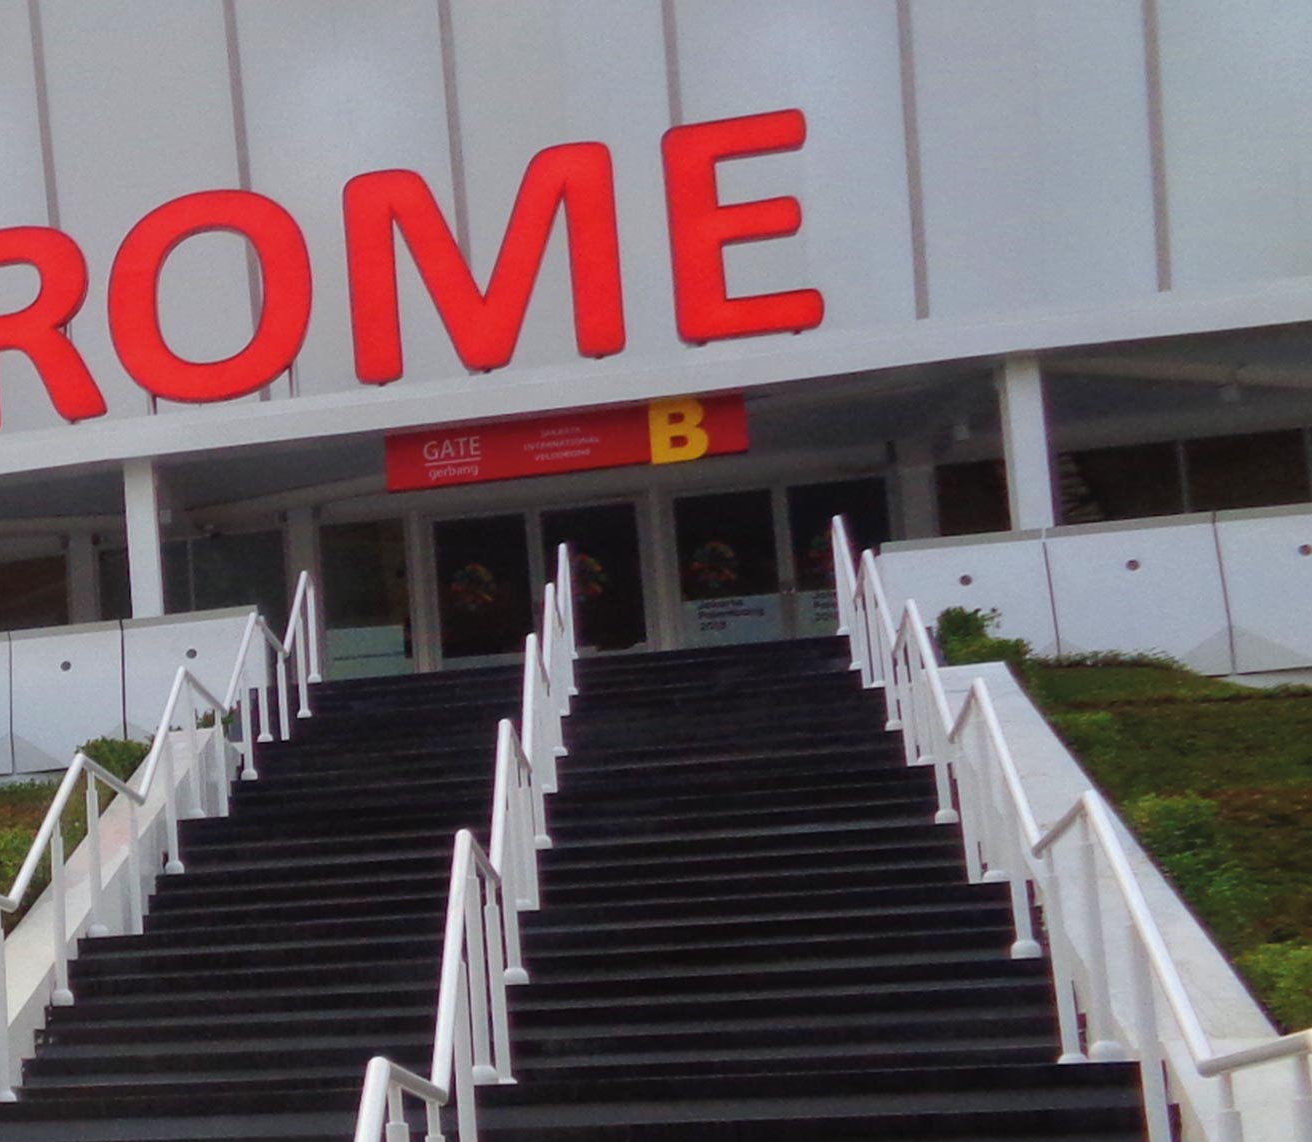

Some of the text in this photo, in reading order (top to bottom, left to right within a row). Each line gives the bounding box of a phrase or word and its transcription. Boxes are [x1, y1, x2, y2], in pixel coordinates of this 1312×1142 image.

[648, 396, 709, 465] B
[423, 435, 482, 461] GATE
[428, 463, 479, 481] gerbang
